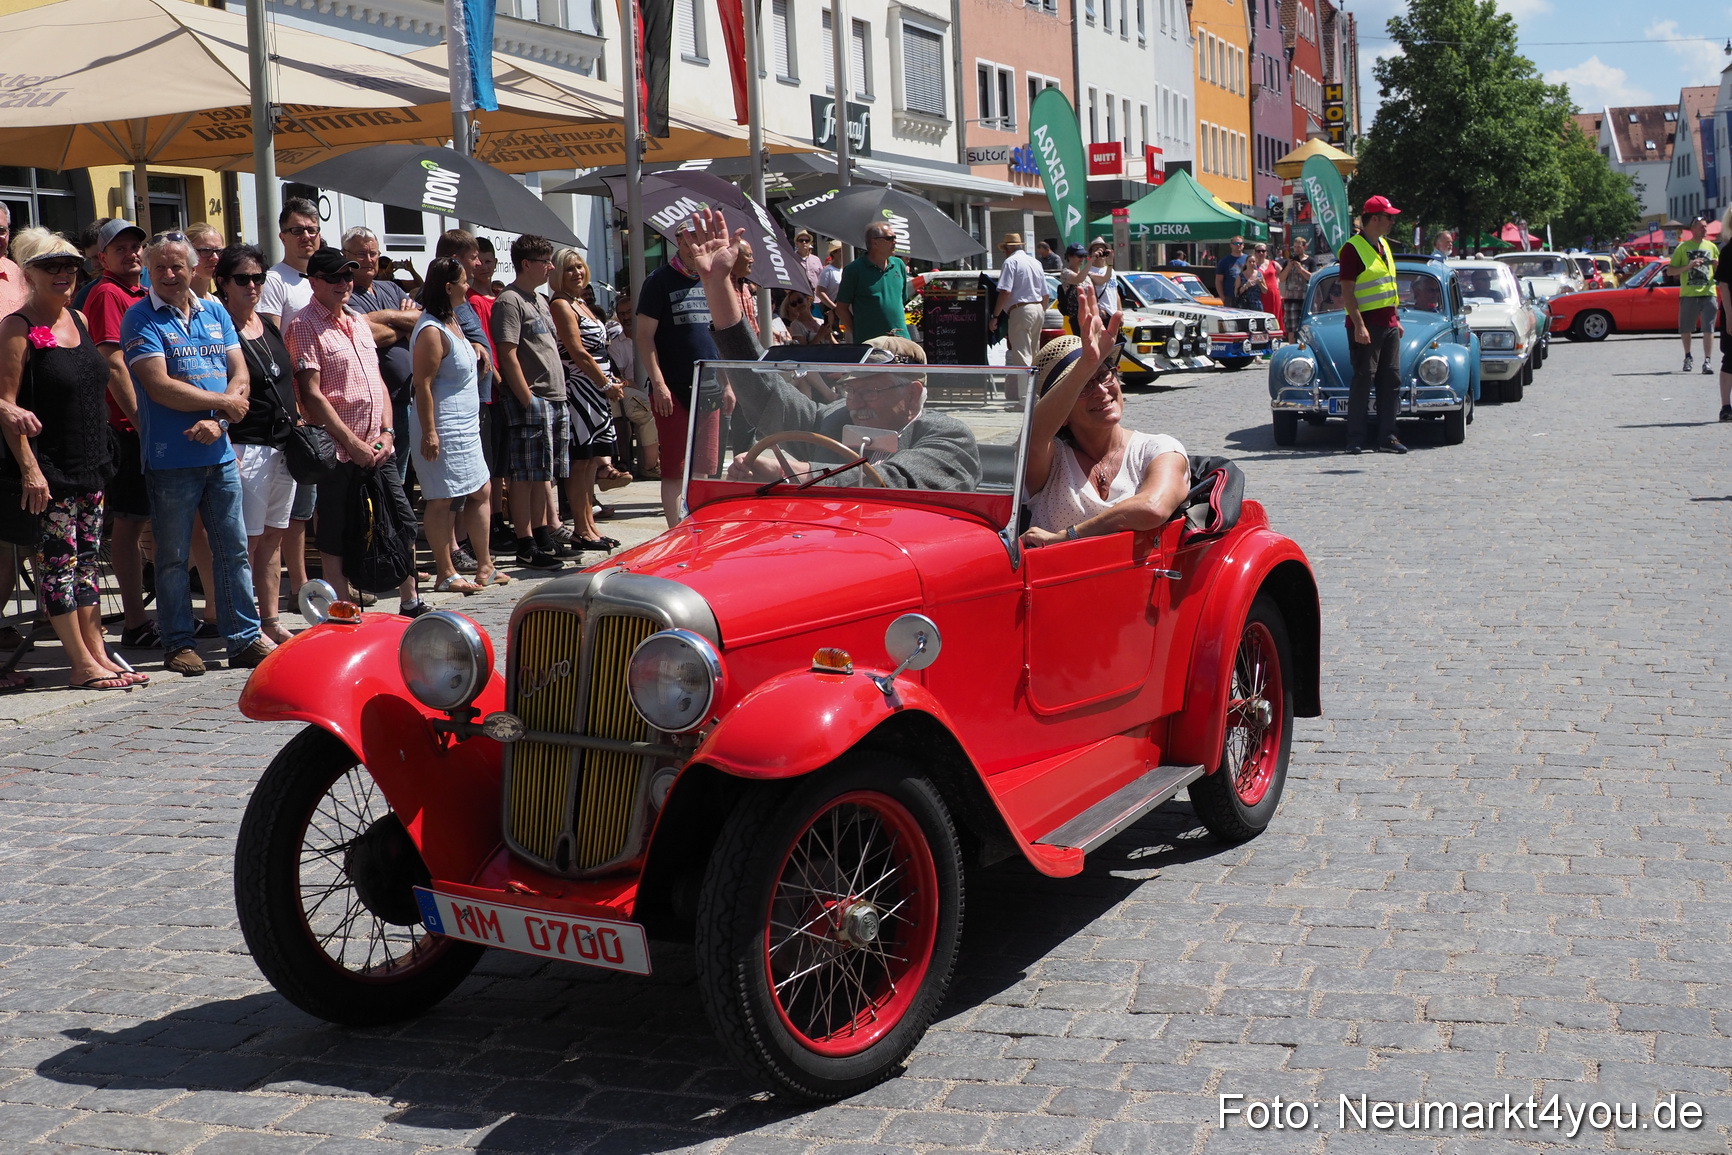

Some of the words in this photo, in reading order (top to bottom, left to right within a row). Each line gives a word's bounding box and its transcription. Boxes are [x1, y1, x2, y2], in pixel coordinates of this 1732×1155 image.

[1324, 86, 1344, 151] HOT
[1093, 153, 1116, 162] WITT
[421, 160, 461, 210] now
[208, 198, 222, 215] 24
[790, 190, 838, 214] now
[1153, 224, 1191, 235] DEKRA
[1157, 309, 1175, 317] JIM
[1179, 311, 1207, 321] BEAM
[450, 902, 505, 943] NM
